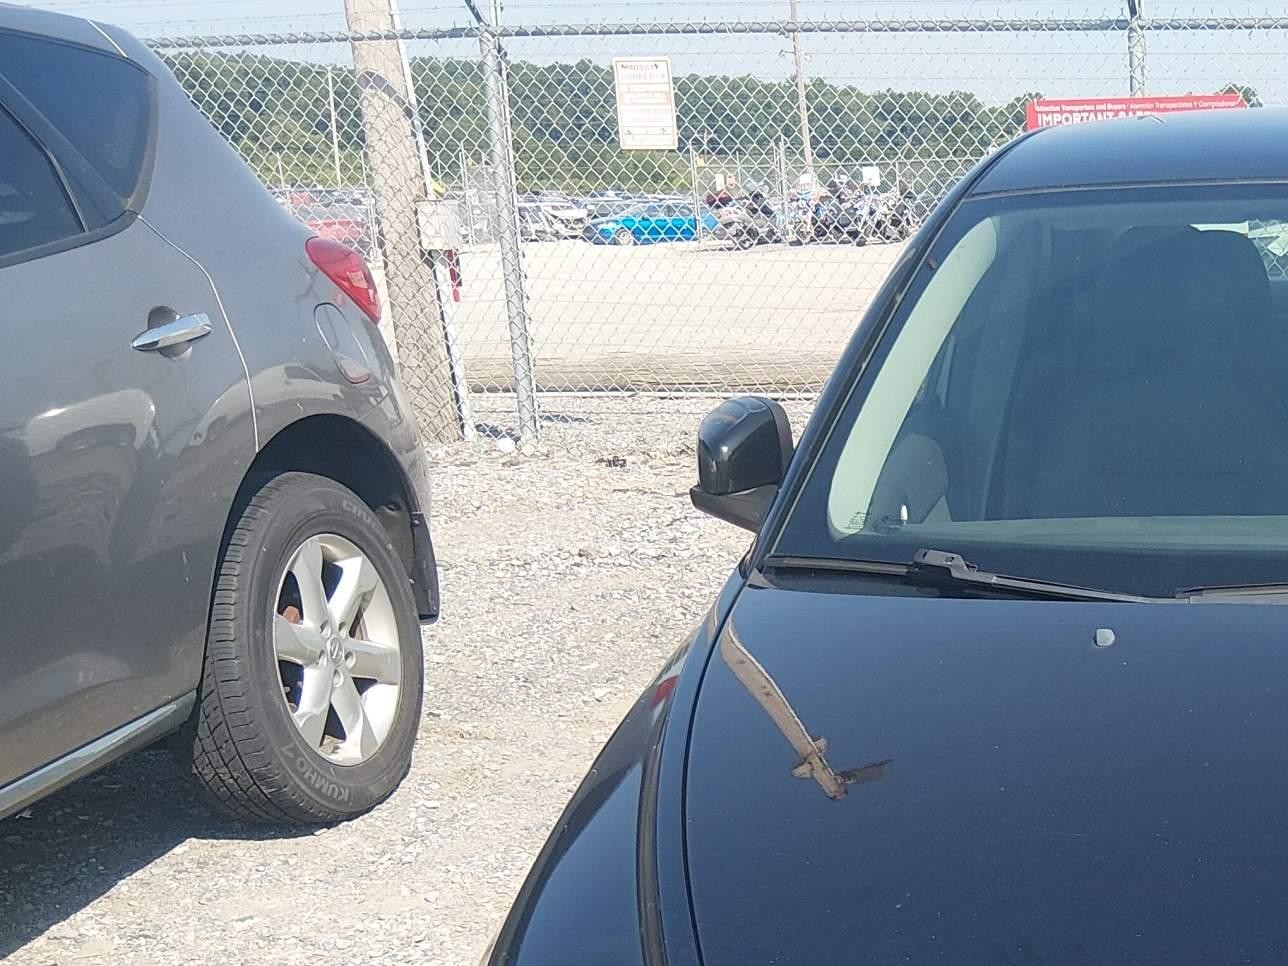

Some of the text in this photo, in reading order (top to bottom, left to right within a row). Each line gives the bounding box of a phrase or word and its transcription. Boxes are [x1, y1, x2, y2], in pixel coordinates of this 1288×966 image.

[1107, 103, 1126, 111] Buyers
[1038, 112, 1114, 127] IMPORTANT
[295, 757, 349, 802] KUMHO
